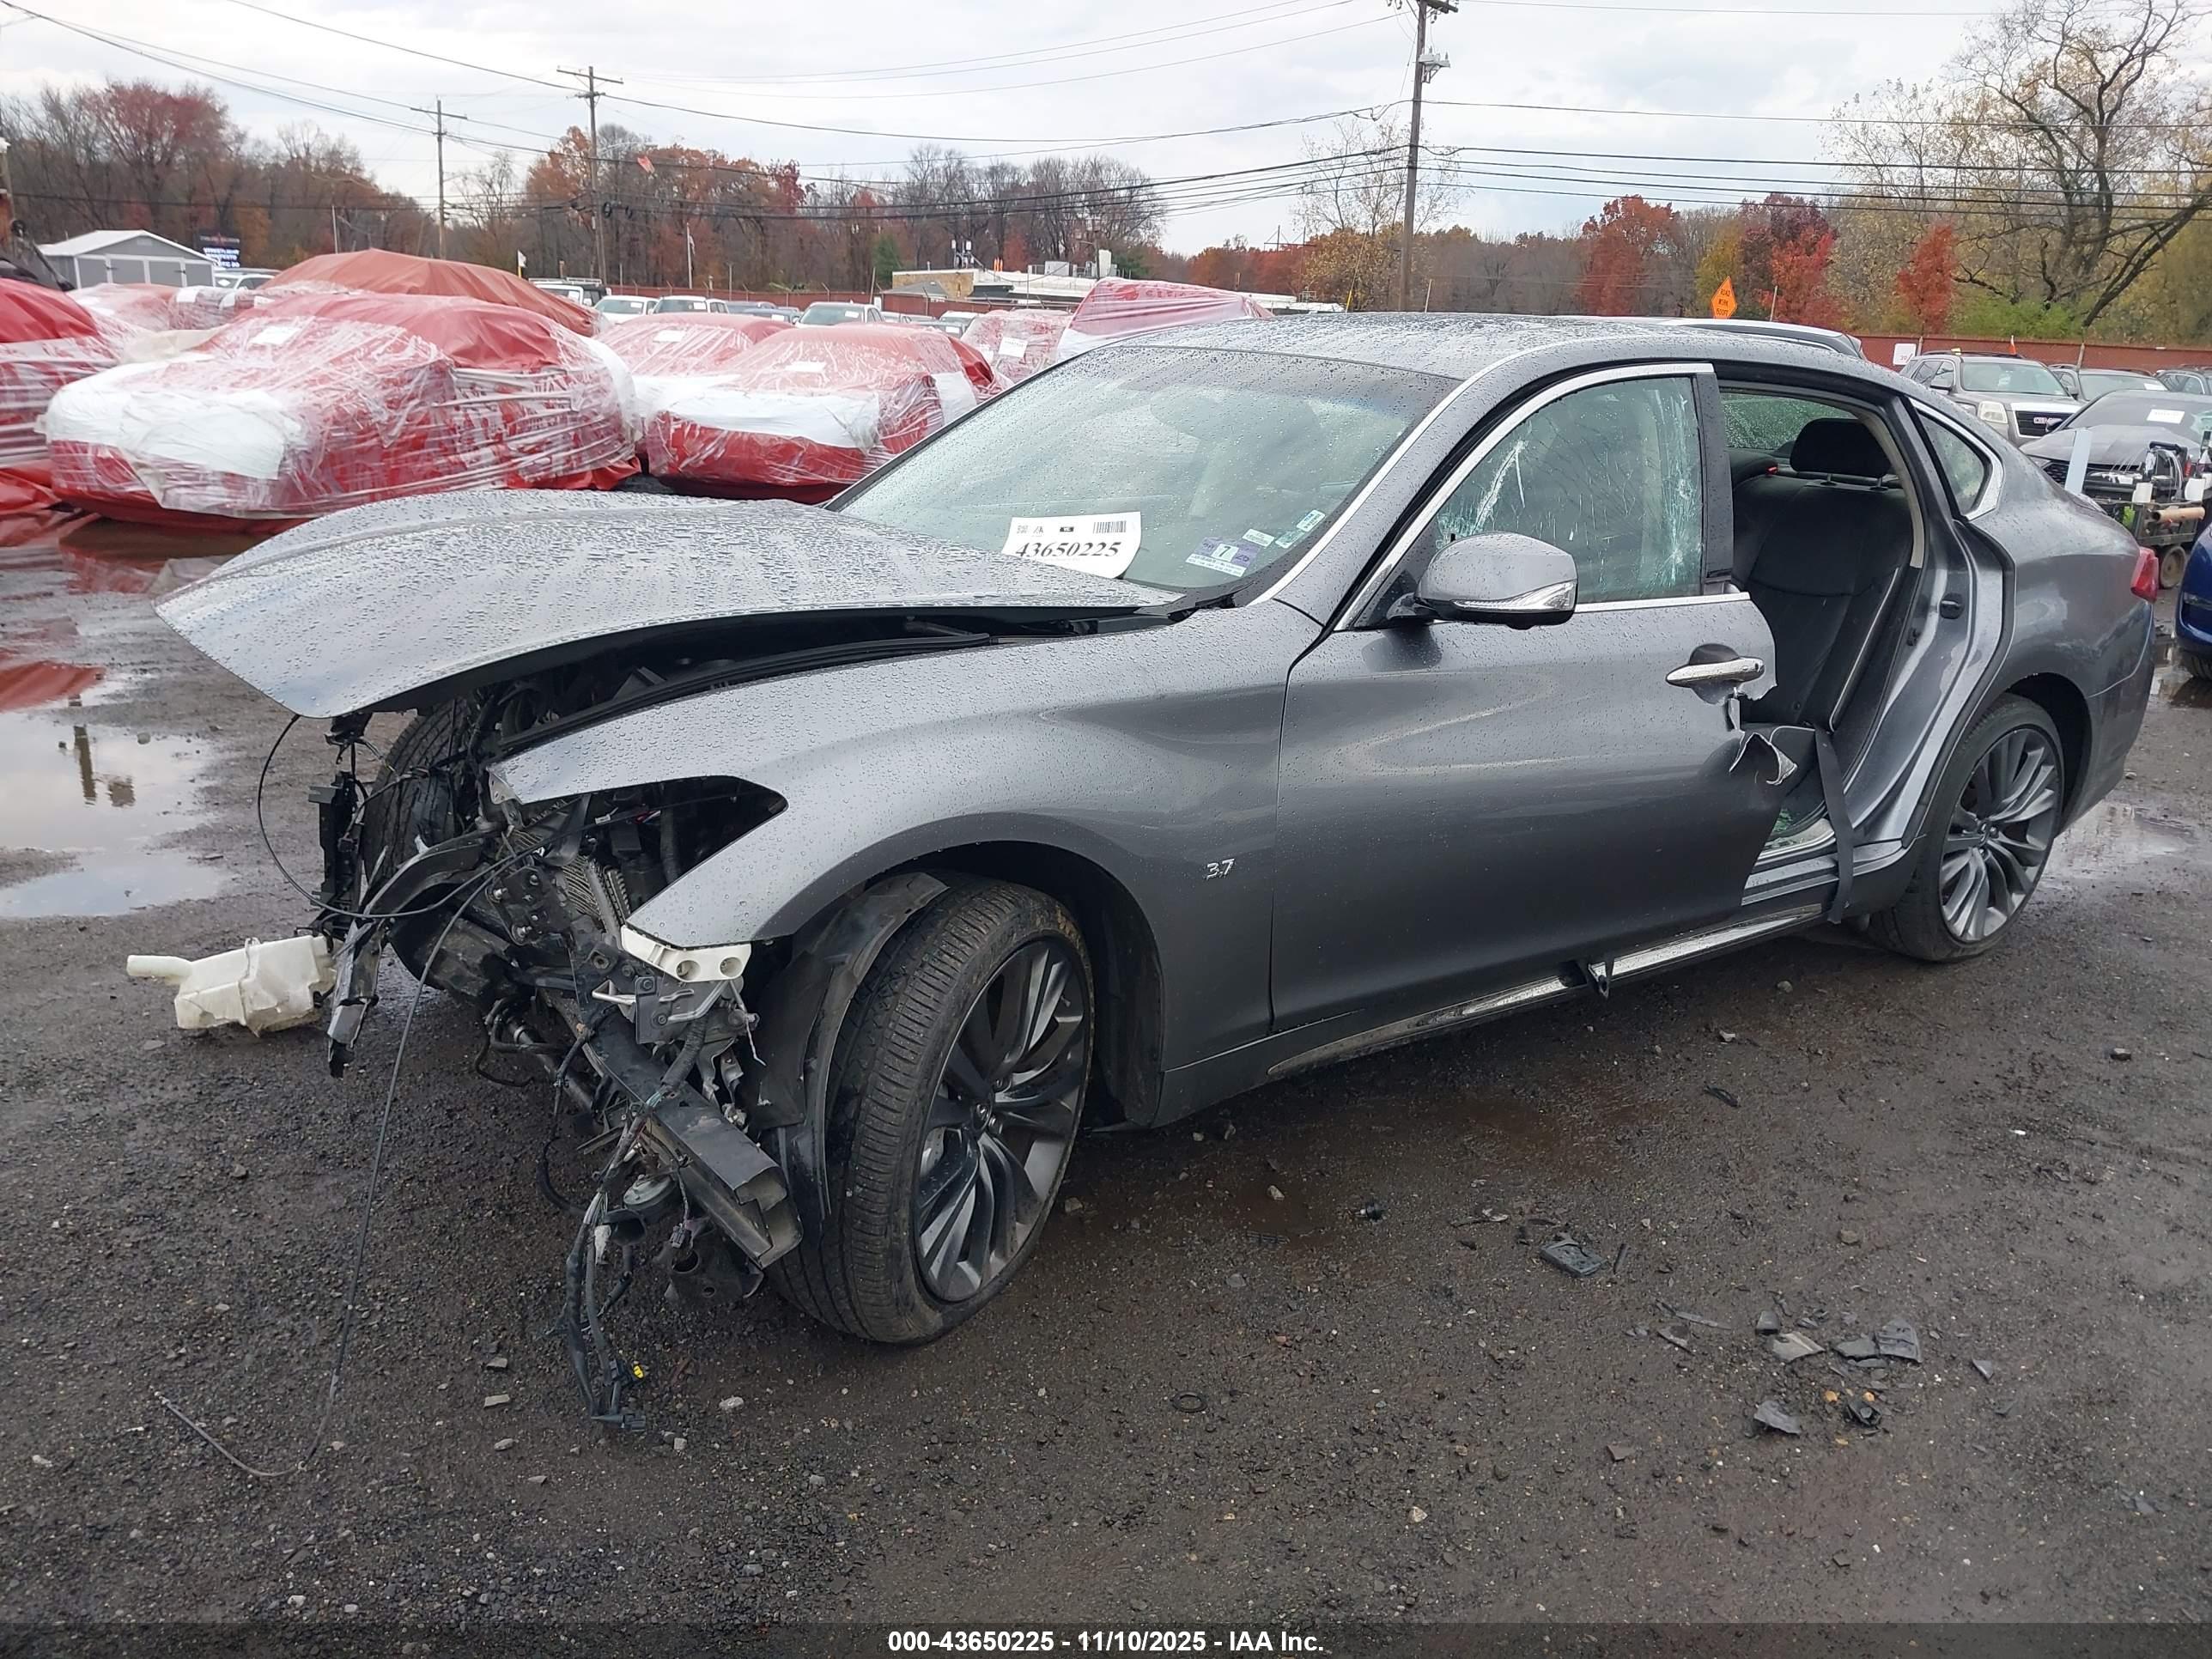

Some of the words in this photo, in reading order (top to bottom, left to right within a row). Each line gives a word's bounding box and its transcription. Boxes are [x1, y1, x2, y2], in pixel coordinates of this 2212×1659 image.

[1015, 541, 1121, 557] 43650225
[1219, 545, 1231, 557] 7
[1206, 859, 1235, 879] 3.7
